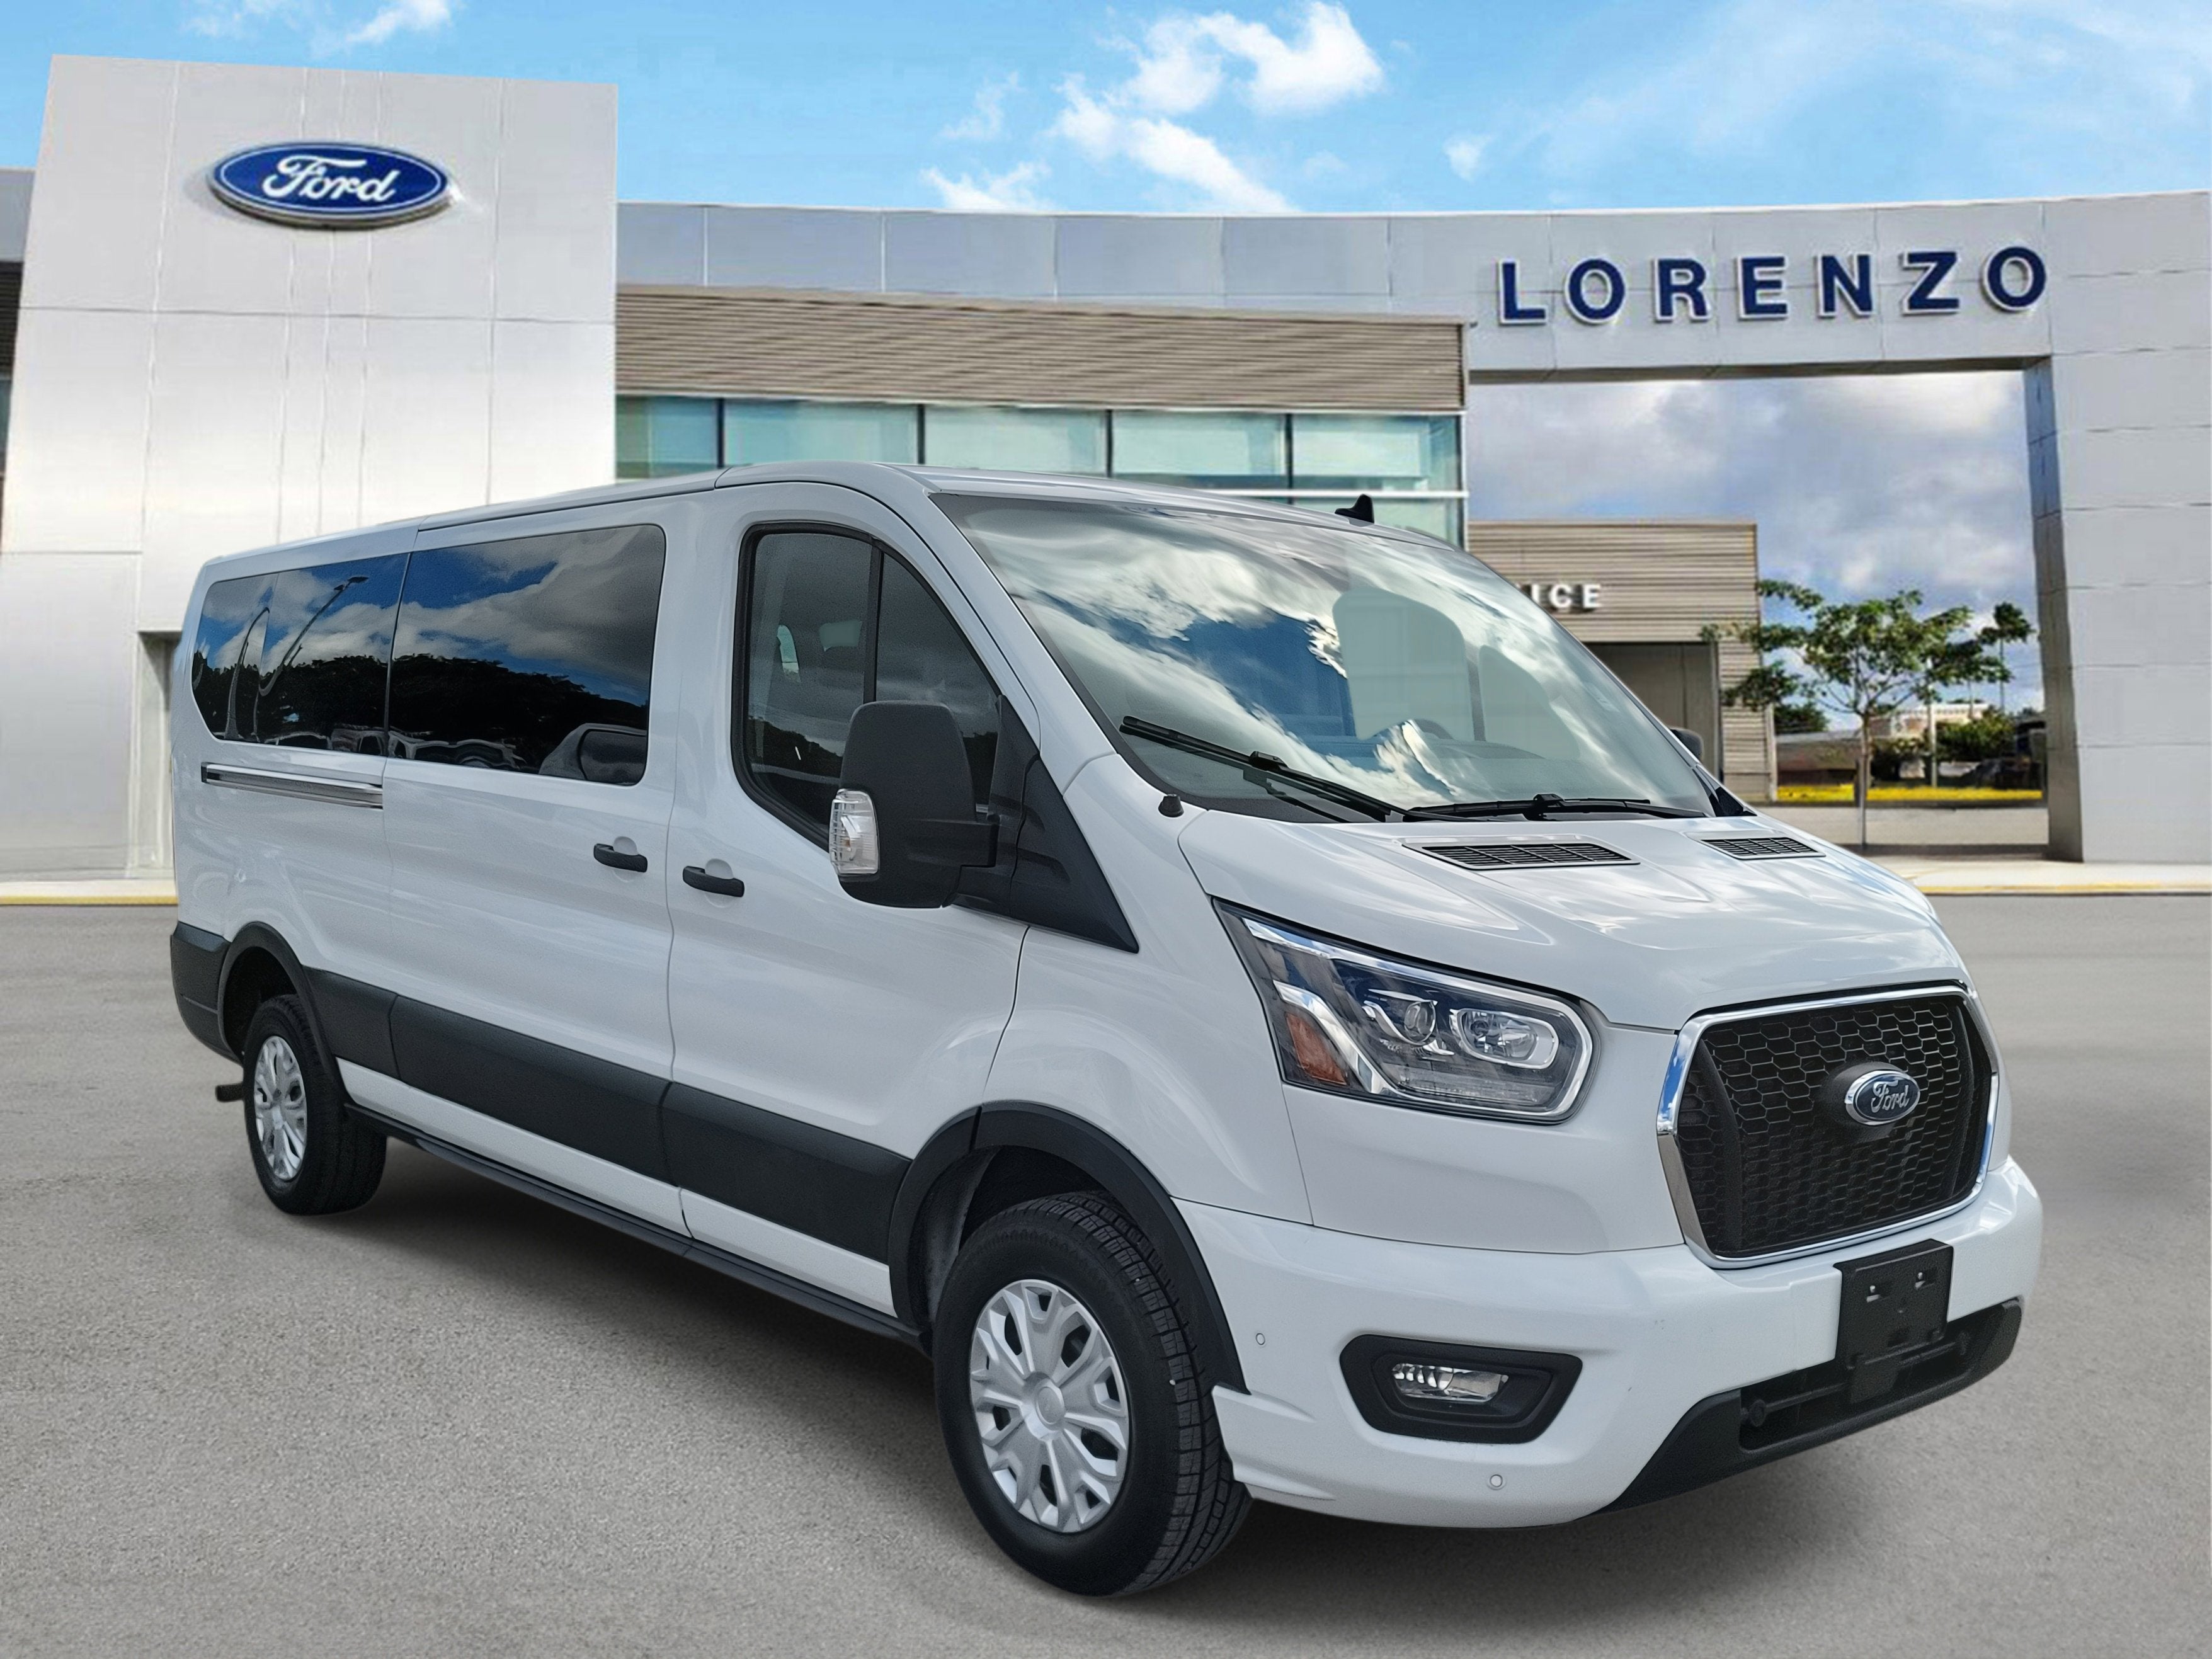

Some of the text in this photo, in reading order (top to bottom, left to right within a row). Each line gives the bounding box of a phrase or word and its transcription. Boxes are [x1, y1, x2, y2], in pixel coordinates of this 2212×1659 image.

[262, 154, 400, 202] Ford
[1499, 246, 2048, 324] LORENZO
[1515, 583, 1603, 608] ICE
[1871, 1079, 1910, 1114] Ford
